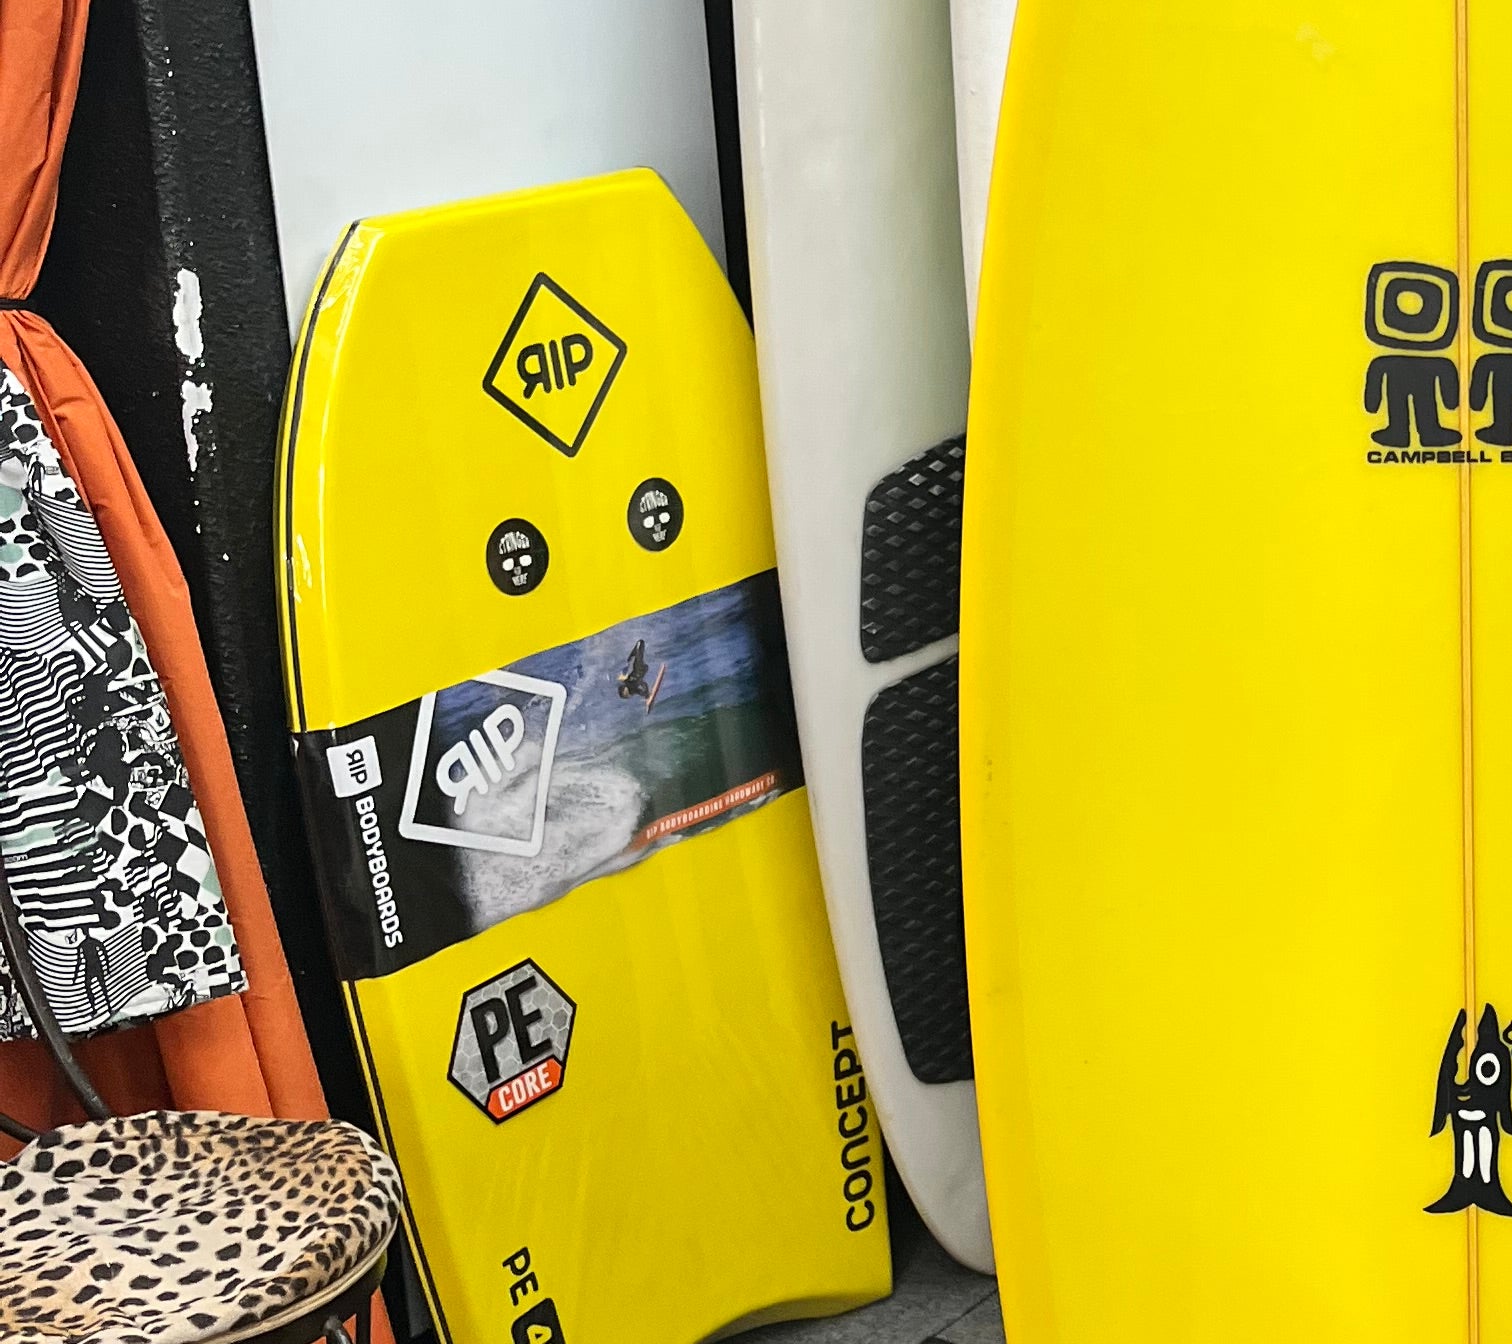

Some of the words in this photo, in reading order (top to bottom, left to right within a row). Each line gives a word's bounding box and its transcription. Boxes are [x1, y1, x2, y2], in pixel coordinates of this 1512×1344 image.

[517, 331, 593, 401] RIP
[1366, 449, 1492, 464] CAMPBELL
[345, 749, 368, 784] RIP
[435, 703, 526, 816] RIP
[355, 795, 404, 949] BODYBOARDS
[468, 974, 554, 1085] PE
[496, 1061, 554, 1113] CORE
[831, 1020, 875, 1232] CONCEPT
[501, 1246, 540, 1306] PE
